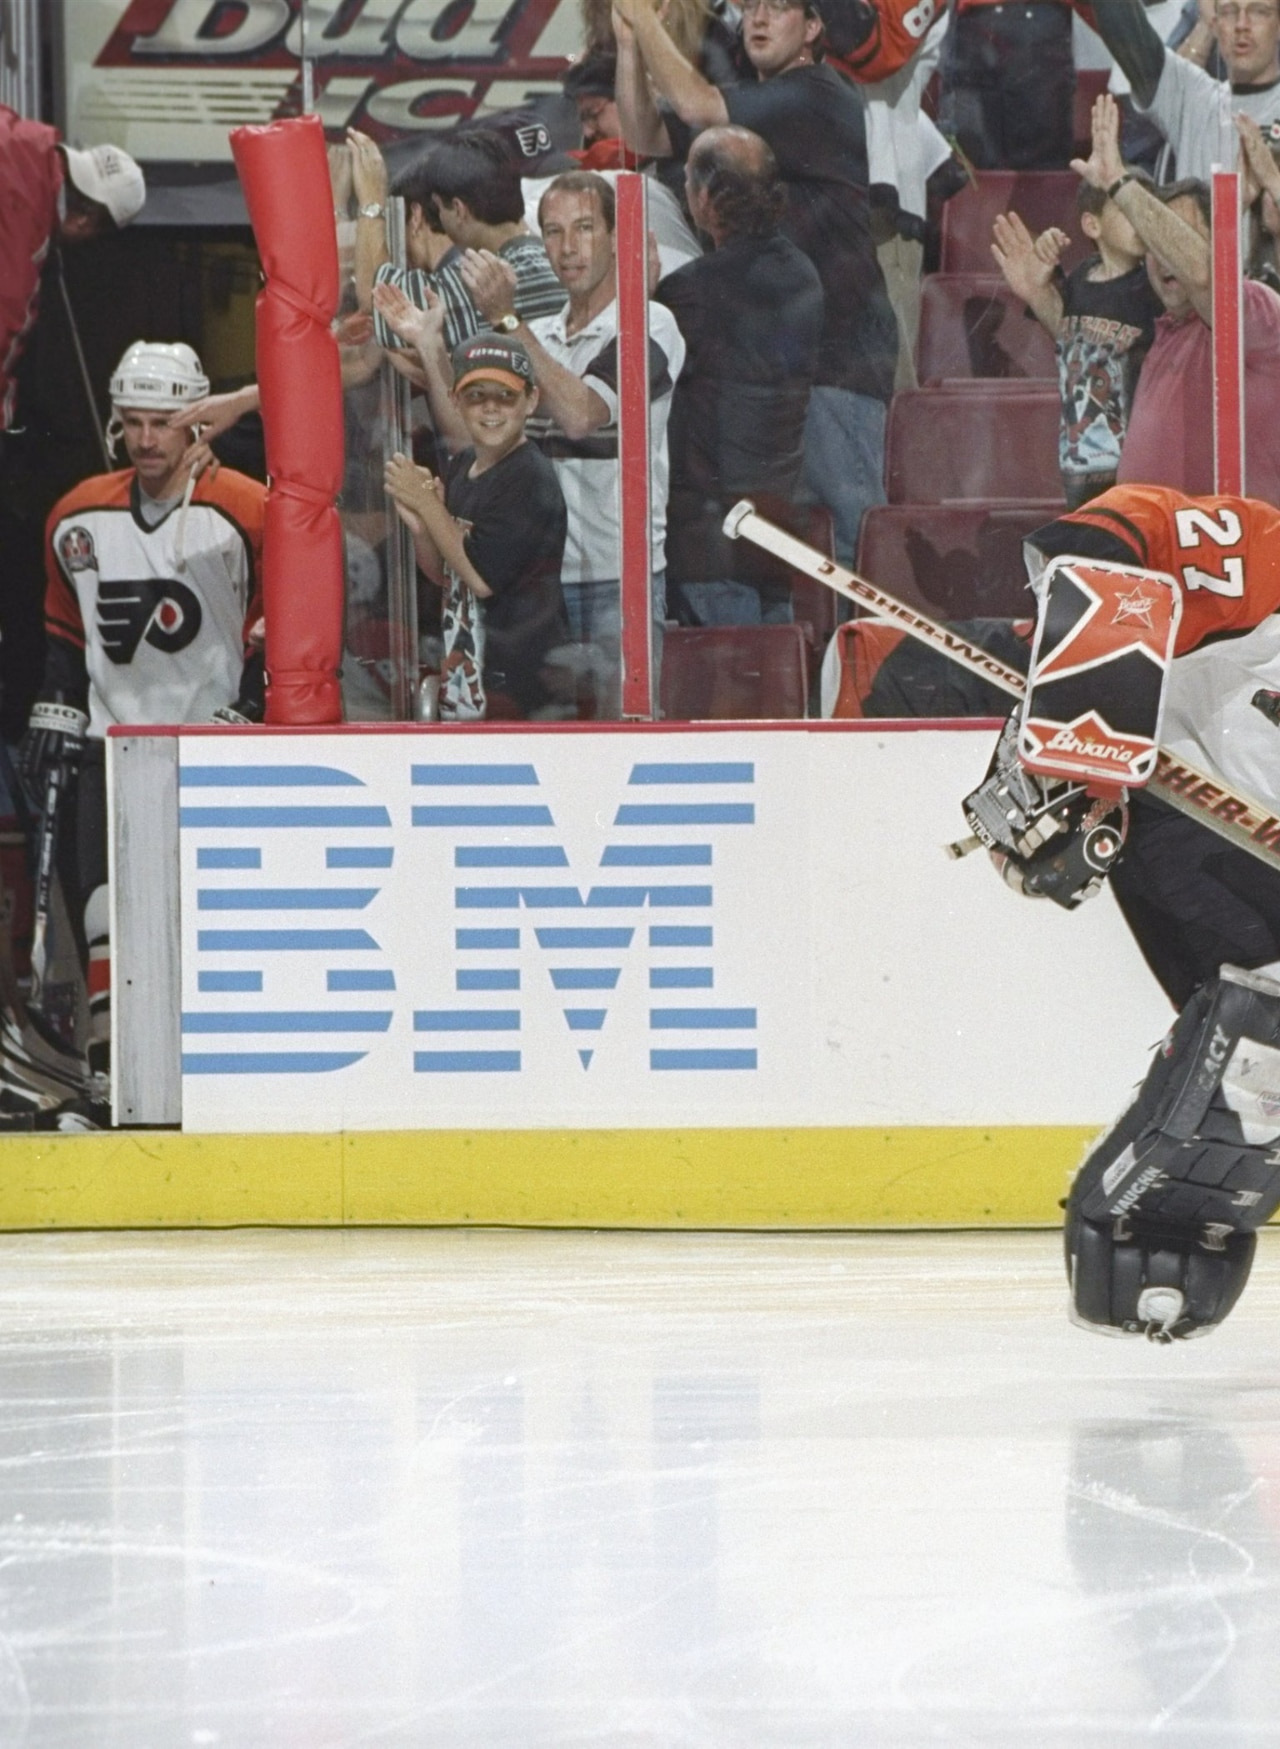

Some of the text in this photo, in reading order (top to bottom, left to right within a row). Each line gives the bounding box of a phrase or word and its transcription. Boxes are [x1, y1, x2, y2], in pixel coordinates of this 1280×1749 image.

[1174, 507, 1245, 598] 27
[847, 579, 1027, 692] SHER-WOO
[1046, 730, 1134, 762] Brian's
[1109, 1165, 1164, 1216] VAUGHN
